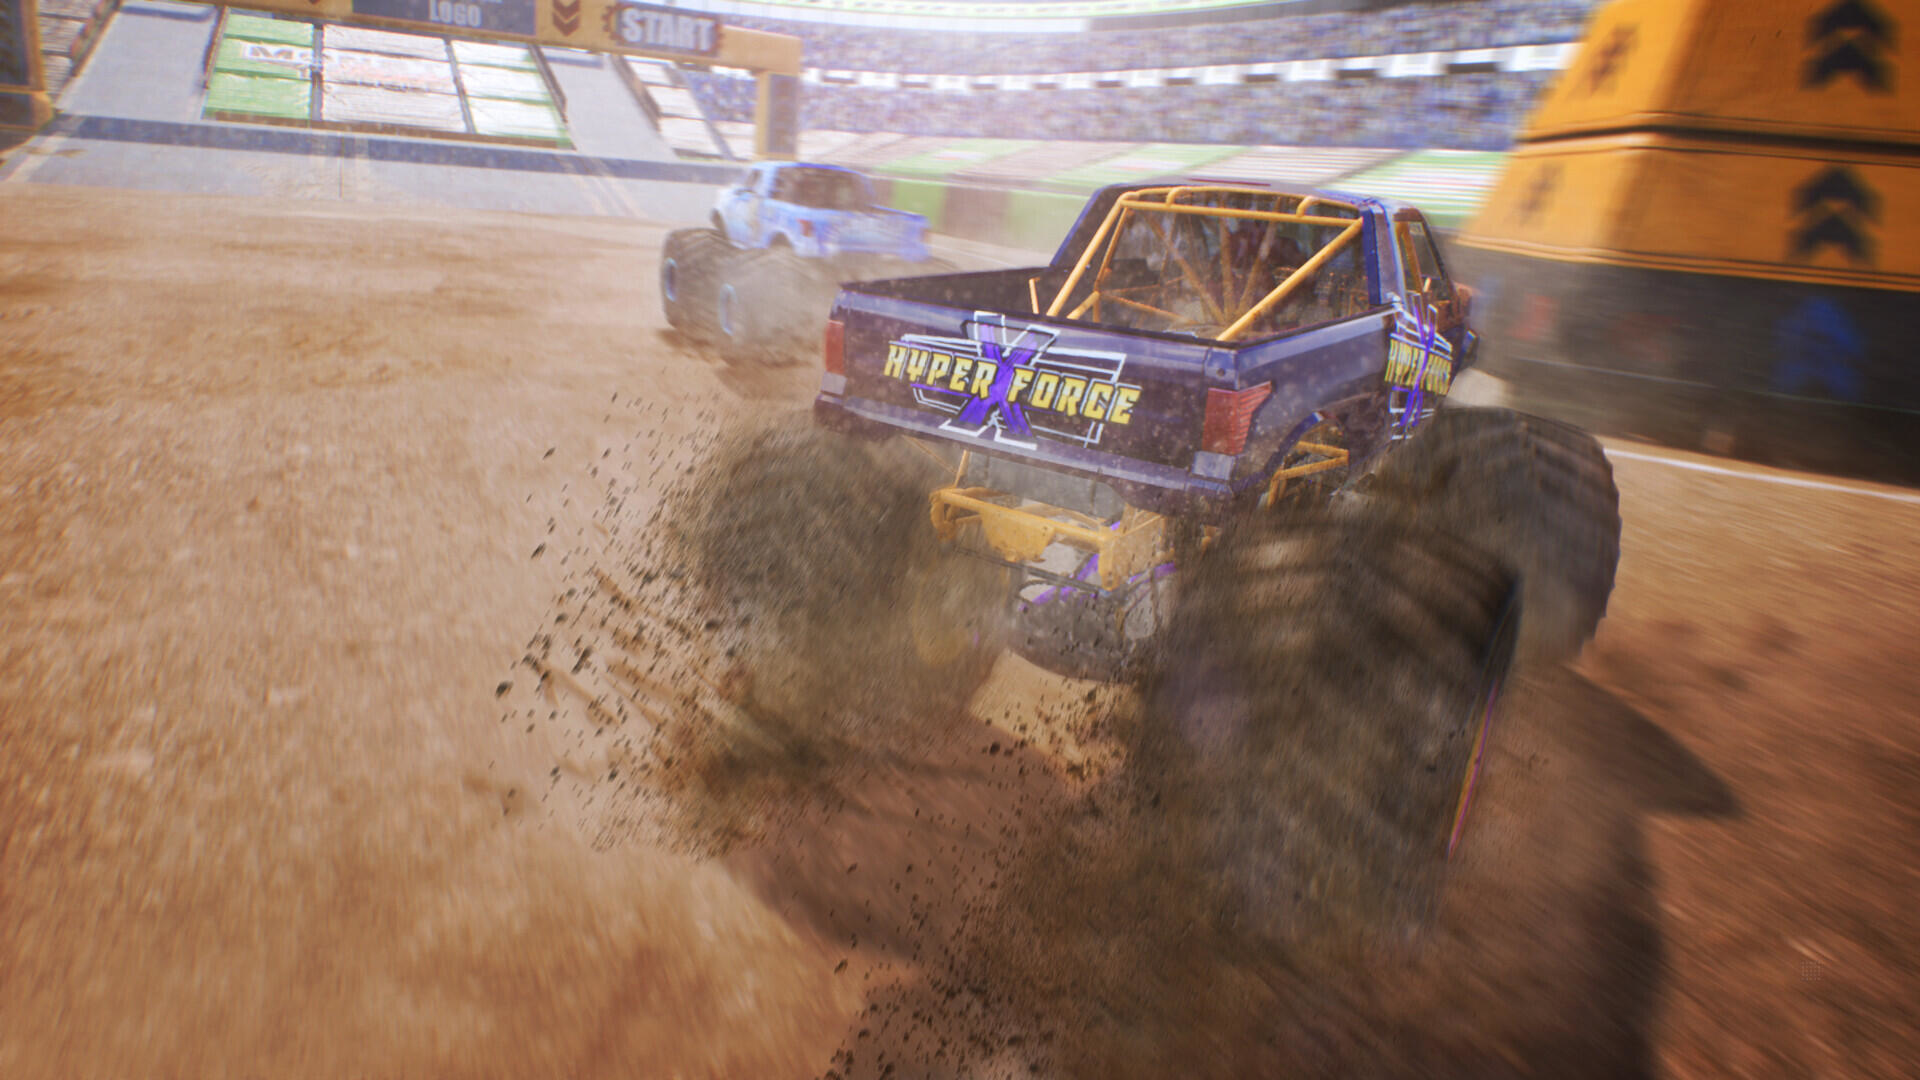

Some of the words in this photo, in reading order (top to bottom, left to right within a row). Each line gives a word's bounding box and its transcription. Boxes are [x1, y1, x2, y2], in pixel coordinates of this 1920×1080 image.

[429, 0, 482, 27] LOGO
[623, 7, 715, 51] START
[883, 341, 998, 400] HYPER
[1007, 363, 1142, 425] FORCE
